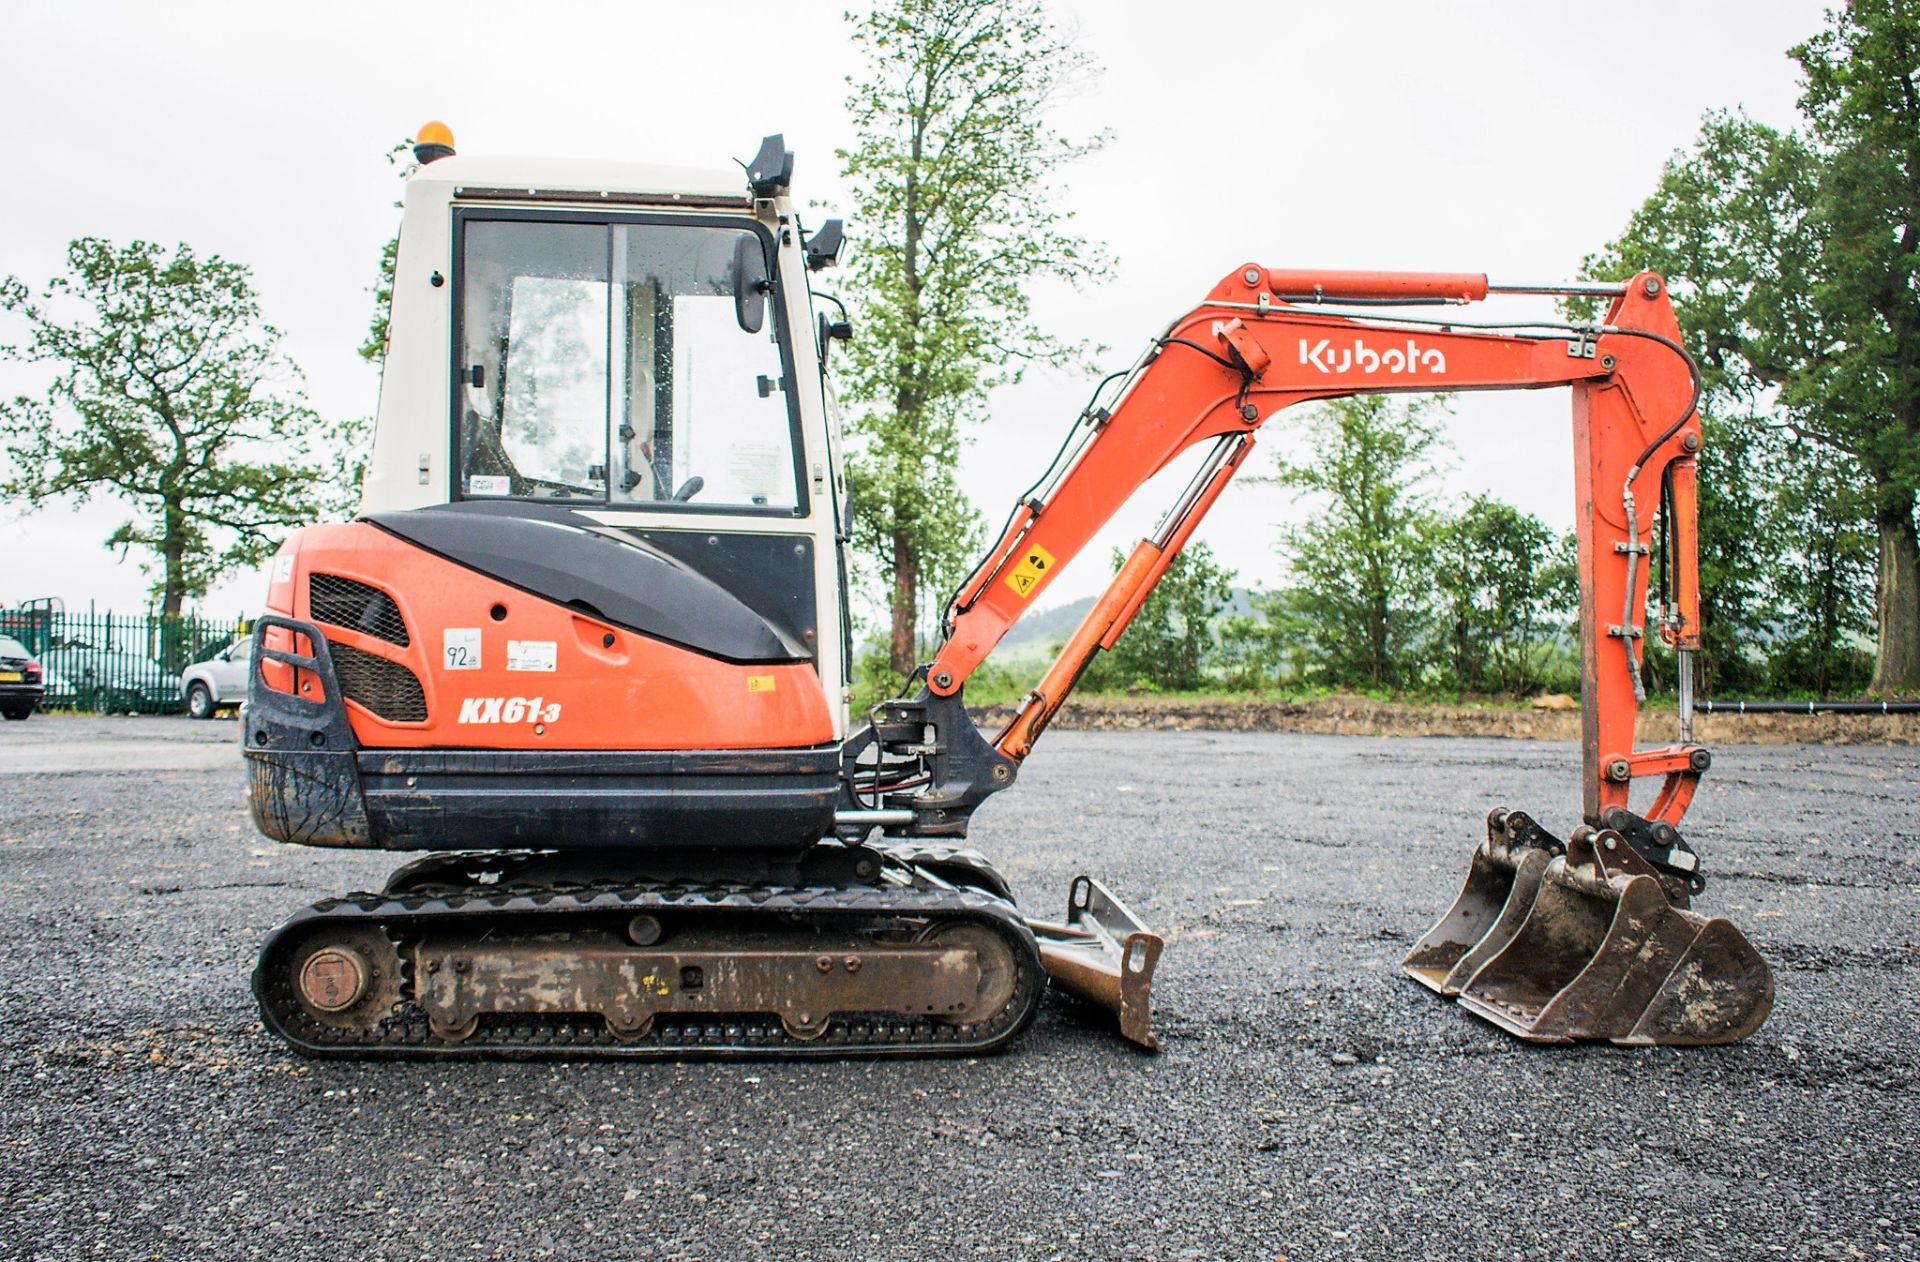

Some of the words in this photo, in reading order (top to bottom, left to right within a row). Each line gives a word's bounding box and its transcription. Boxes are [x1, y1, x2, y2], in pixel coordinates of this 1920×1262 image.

[1299, 339, 1446, 373] Kubota
[447, 647, 467, 666] 92
[457, 697, 562, 724] KX61-3
